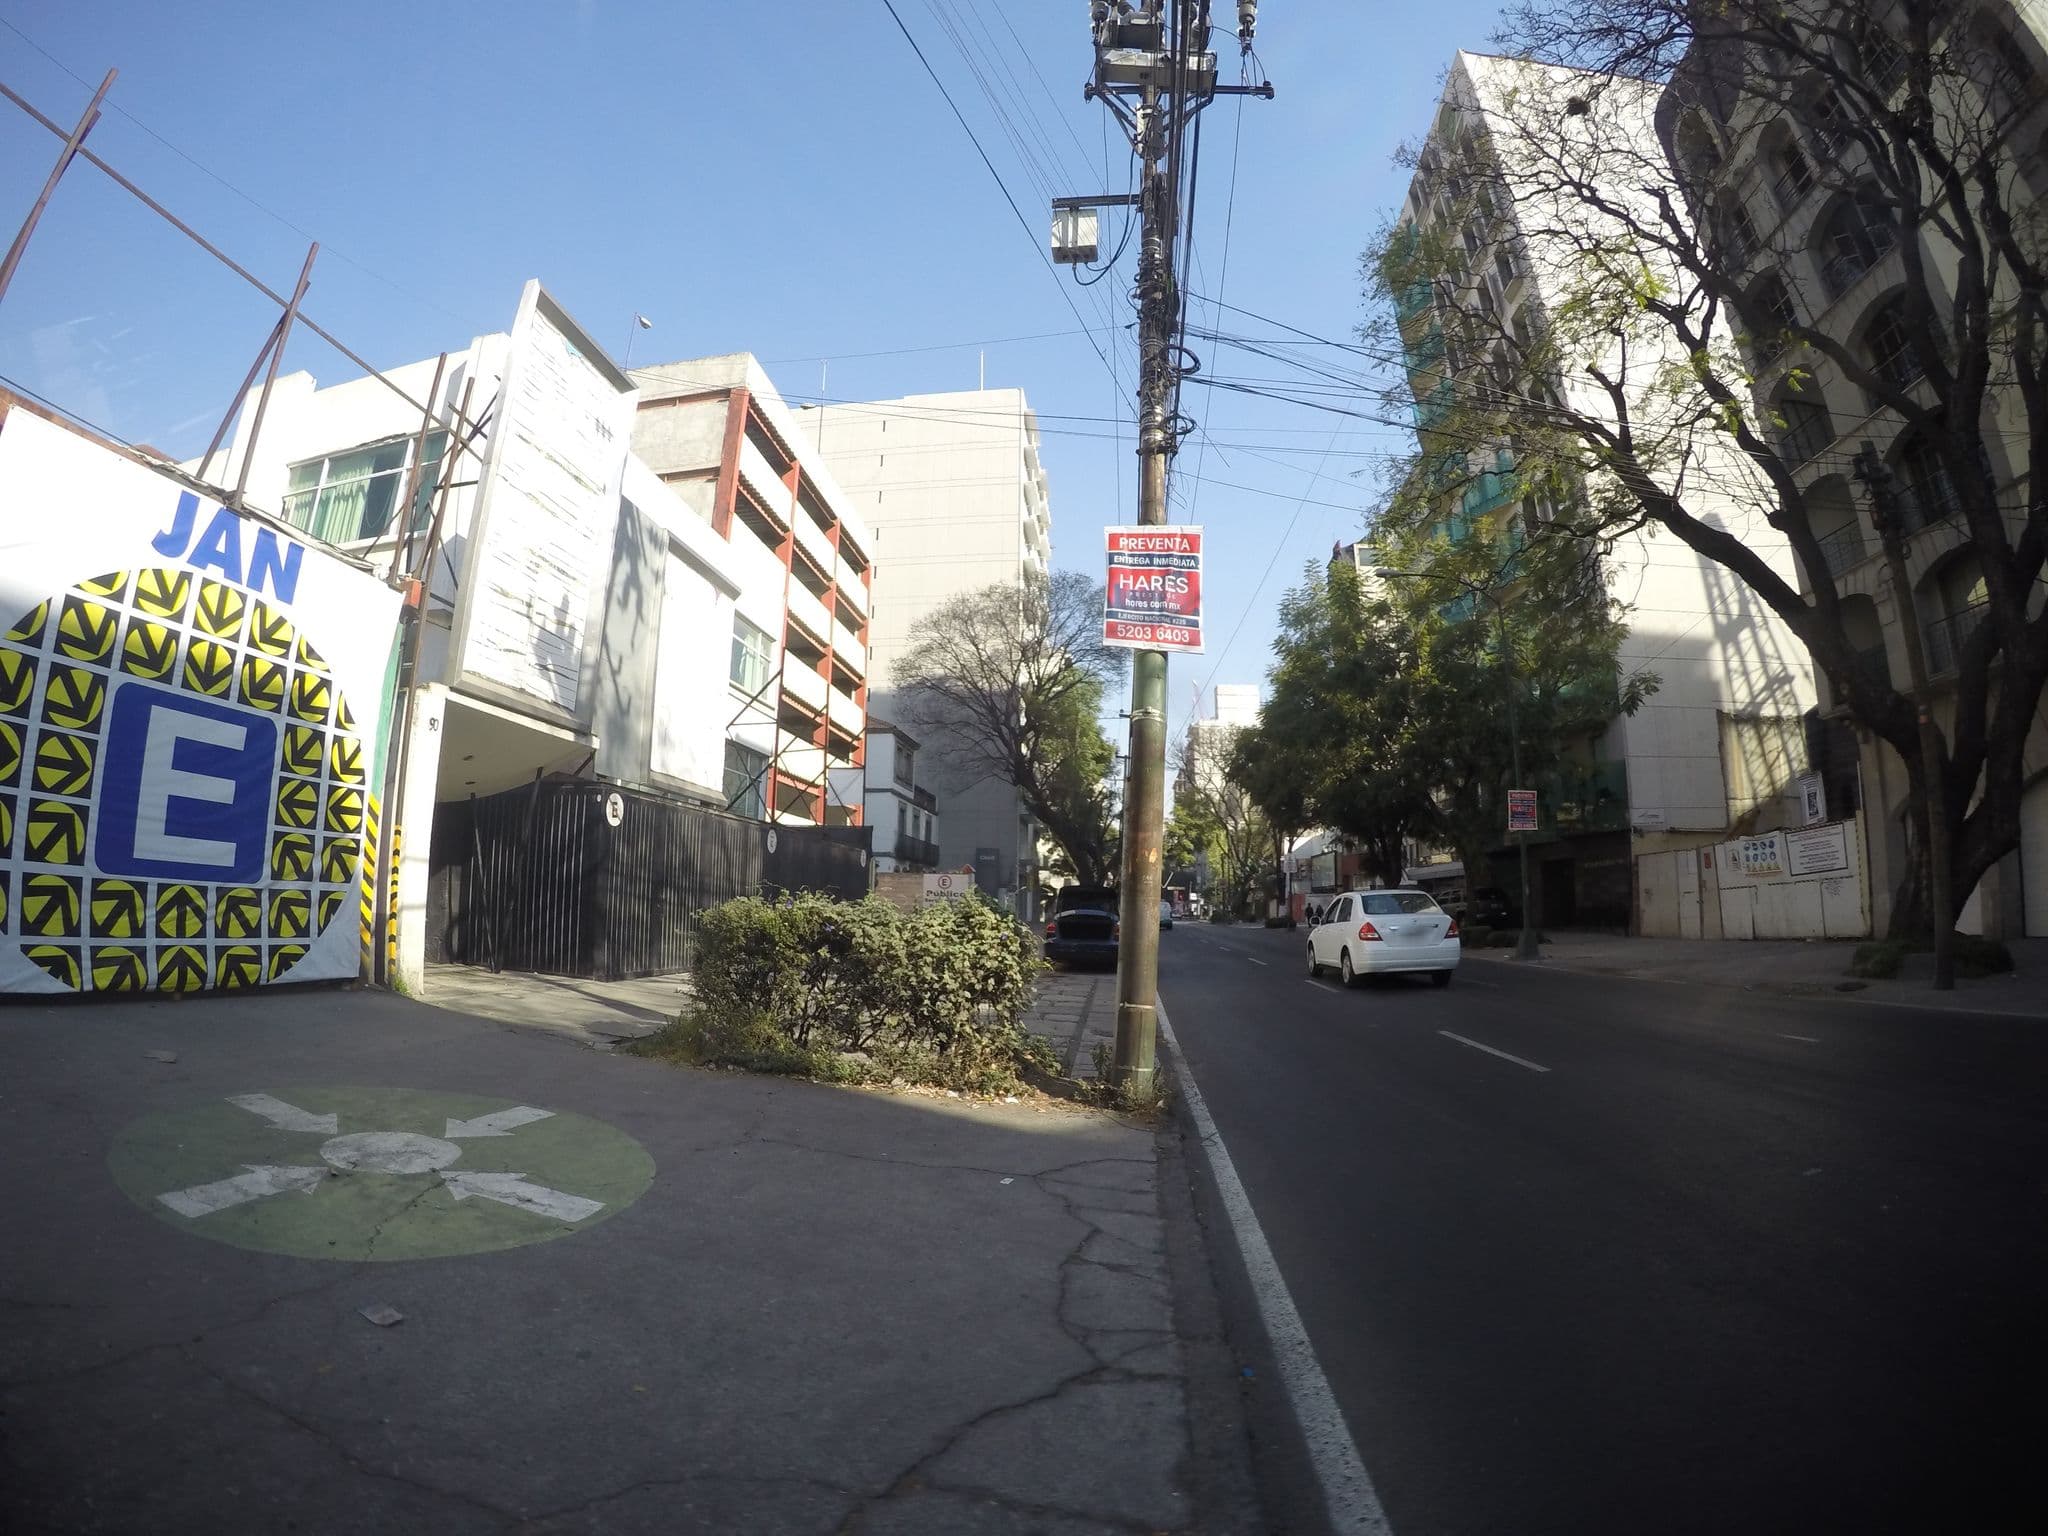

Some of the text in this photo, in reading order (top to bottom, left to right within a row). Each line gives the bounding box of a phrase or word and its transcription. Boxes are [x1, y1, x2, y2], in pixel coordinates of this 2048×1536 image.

[151, 490, 305, 606] JAN
[1119, 537, 1191, 551] PREVENTA
[1113, 555, 1196, 567] ENTREGA INMEDIATA
[1119, 573, 1189, 594] HARES
[1117, 624, 1190, 643] 5203 6403
[429, 717, 439, 731] 90
[133, 705, 248, 867] E
